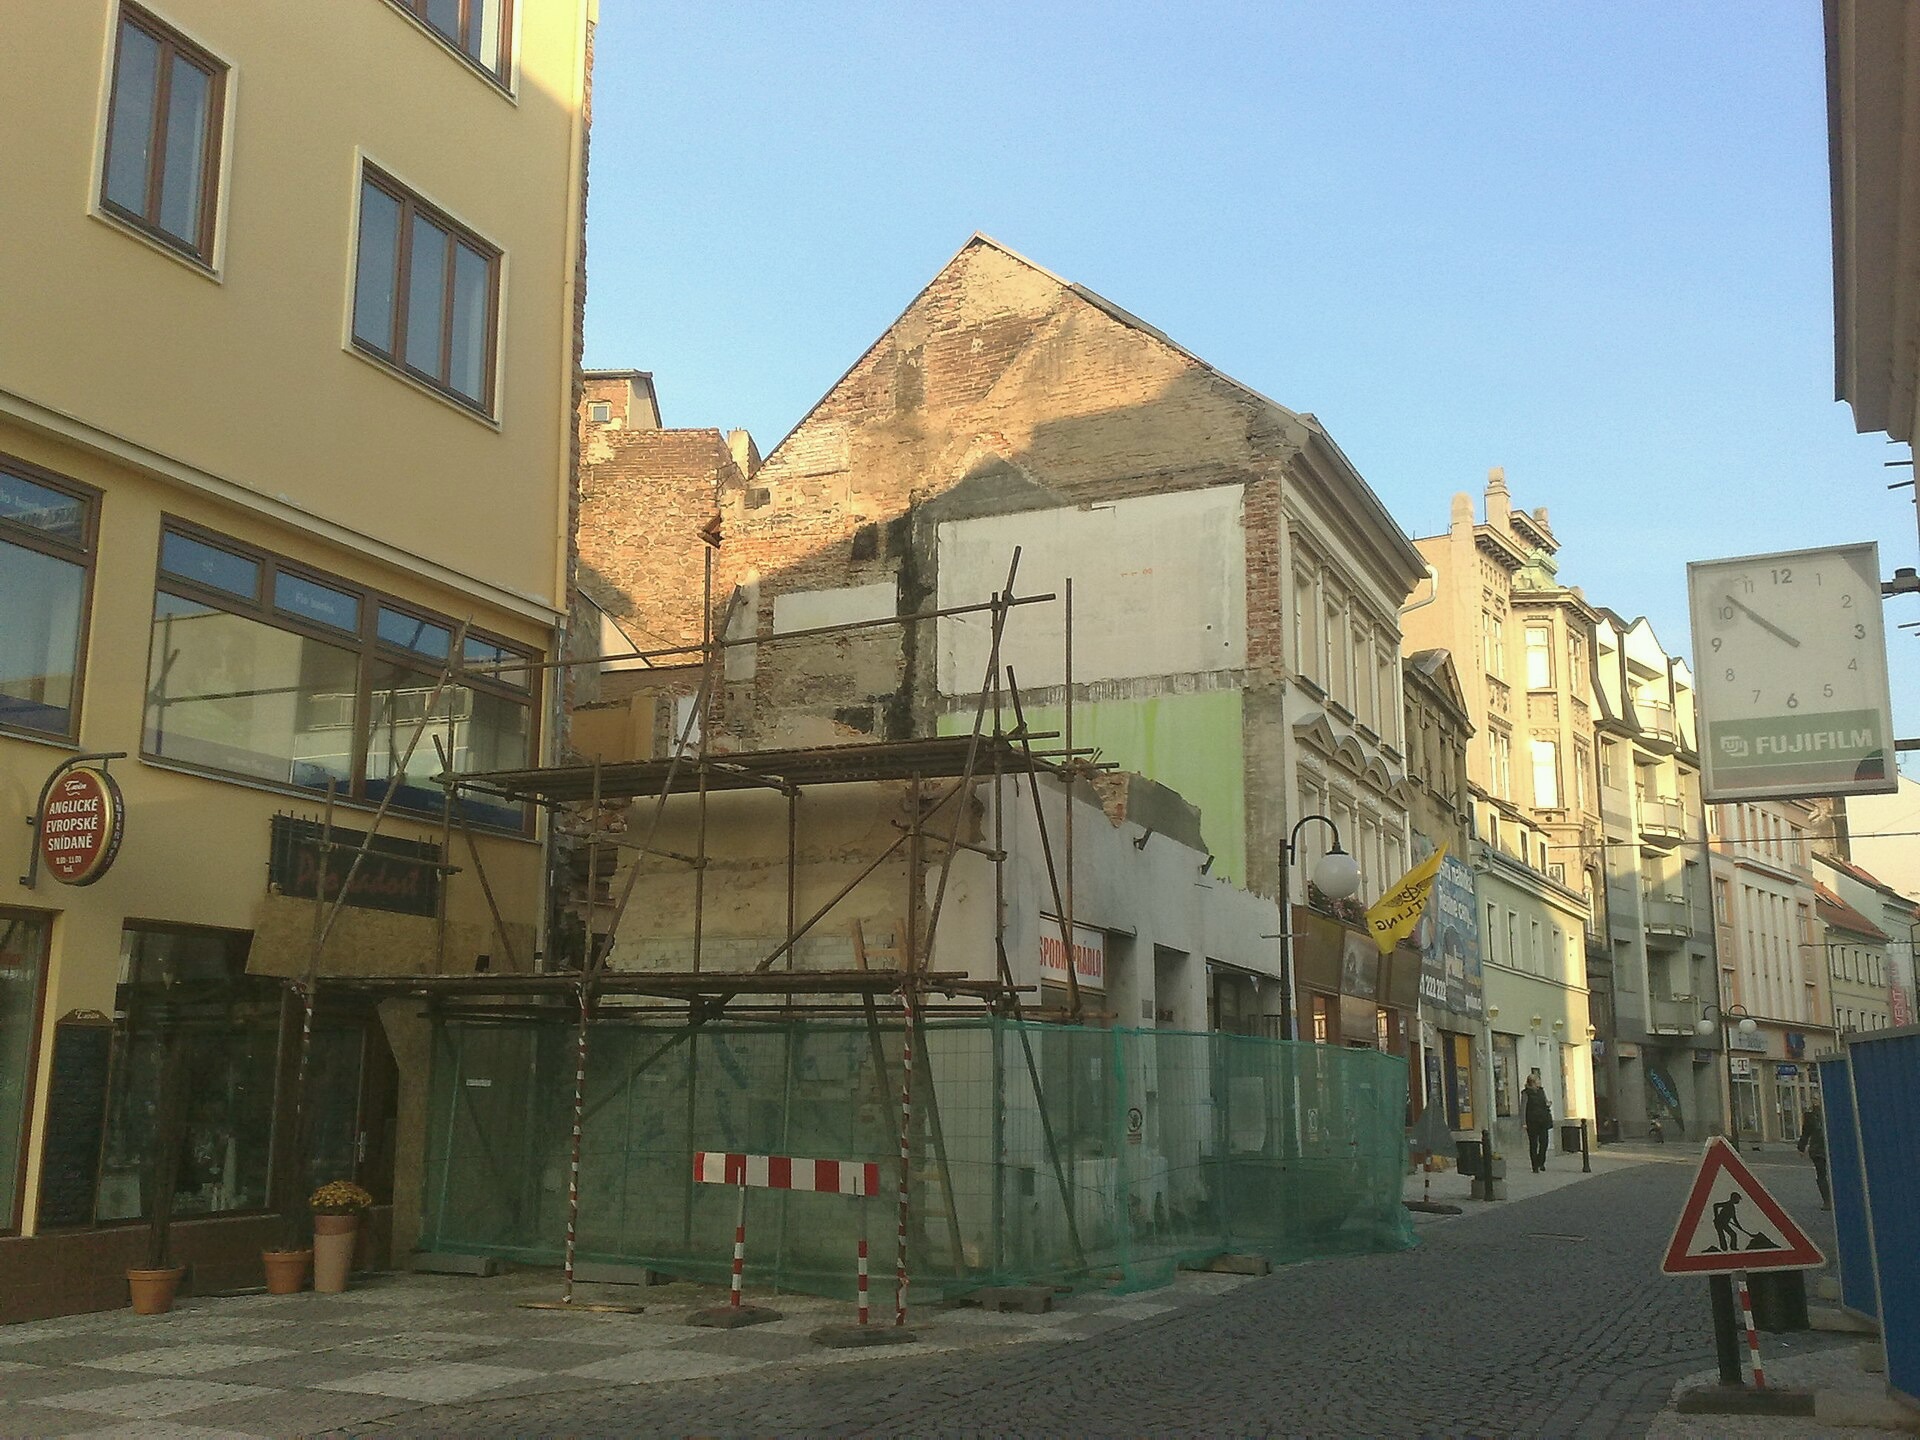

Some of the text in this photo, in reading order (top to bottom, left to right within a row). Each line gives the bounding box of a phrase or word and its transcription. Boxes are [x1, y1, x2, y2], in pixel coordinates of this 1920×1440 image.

[1770, 568, 1793, 585] 12
[1815, 572, 1822, 586] 1
[1743, 580, 1755, 594] 11
[1841, 594, 1853, 609] 2
[1718, 606, 1734, 621] 10
[1853, 623, 1866, 640] 3
[1711, 637, 1723, 653] 9
[1847, 658, 1858, 672] 4
[1725, 667, 1736, 682] 8
[1751, 689, 1761, 705] 7
[1823, 683, 1834, 698] 5
[1786, 692, 1799, 709] 6
[1755, 728, 1874, 755] FUJIFILM
[48, 796, 99, 815] ANGLICKÉ
[46, 814, 99, 834] EVROPSKÉ
[47, 832, 93, 852] SNÍDANĚ
[1040, 935, 1069, 971] SPODN
